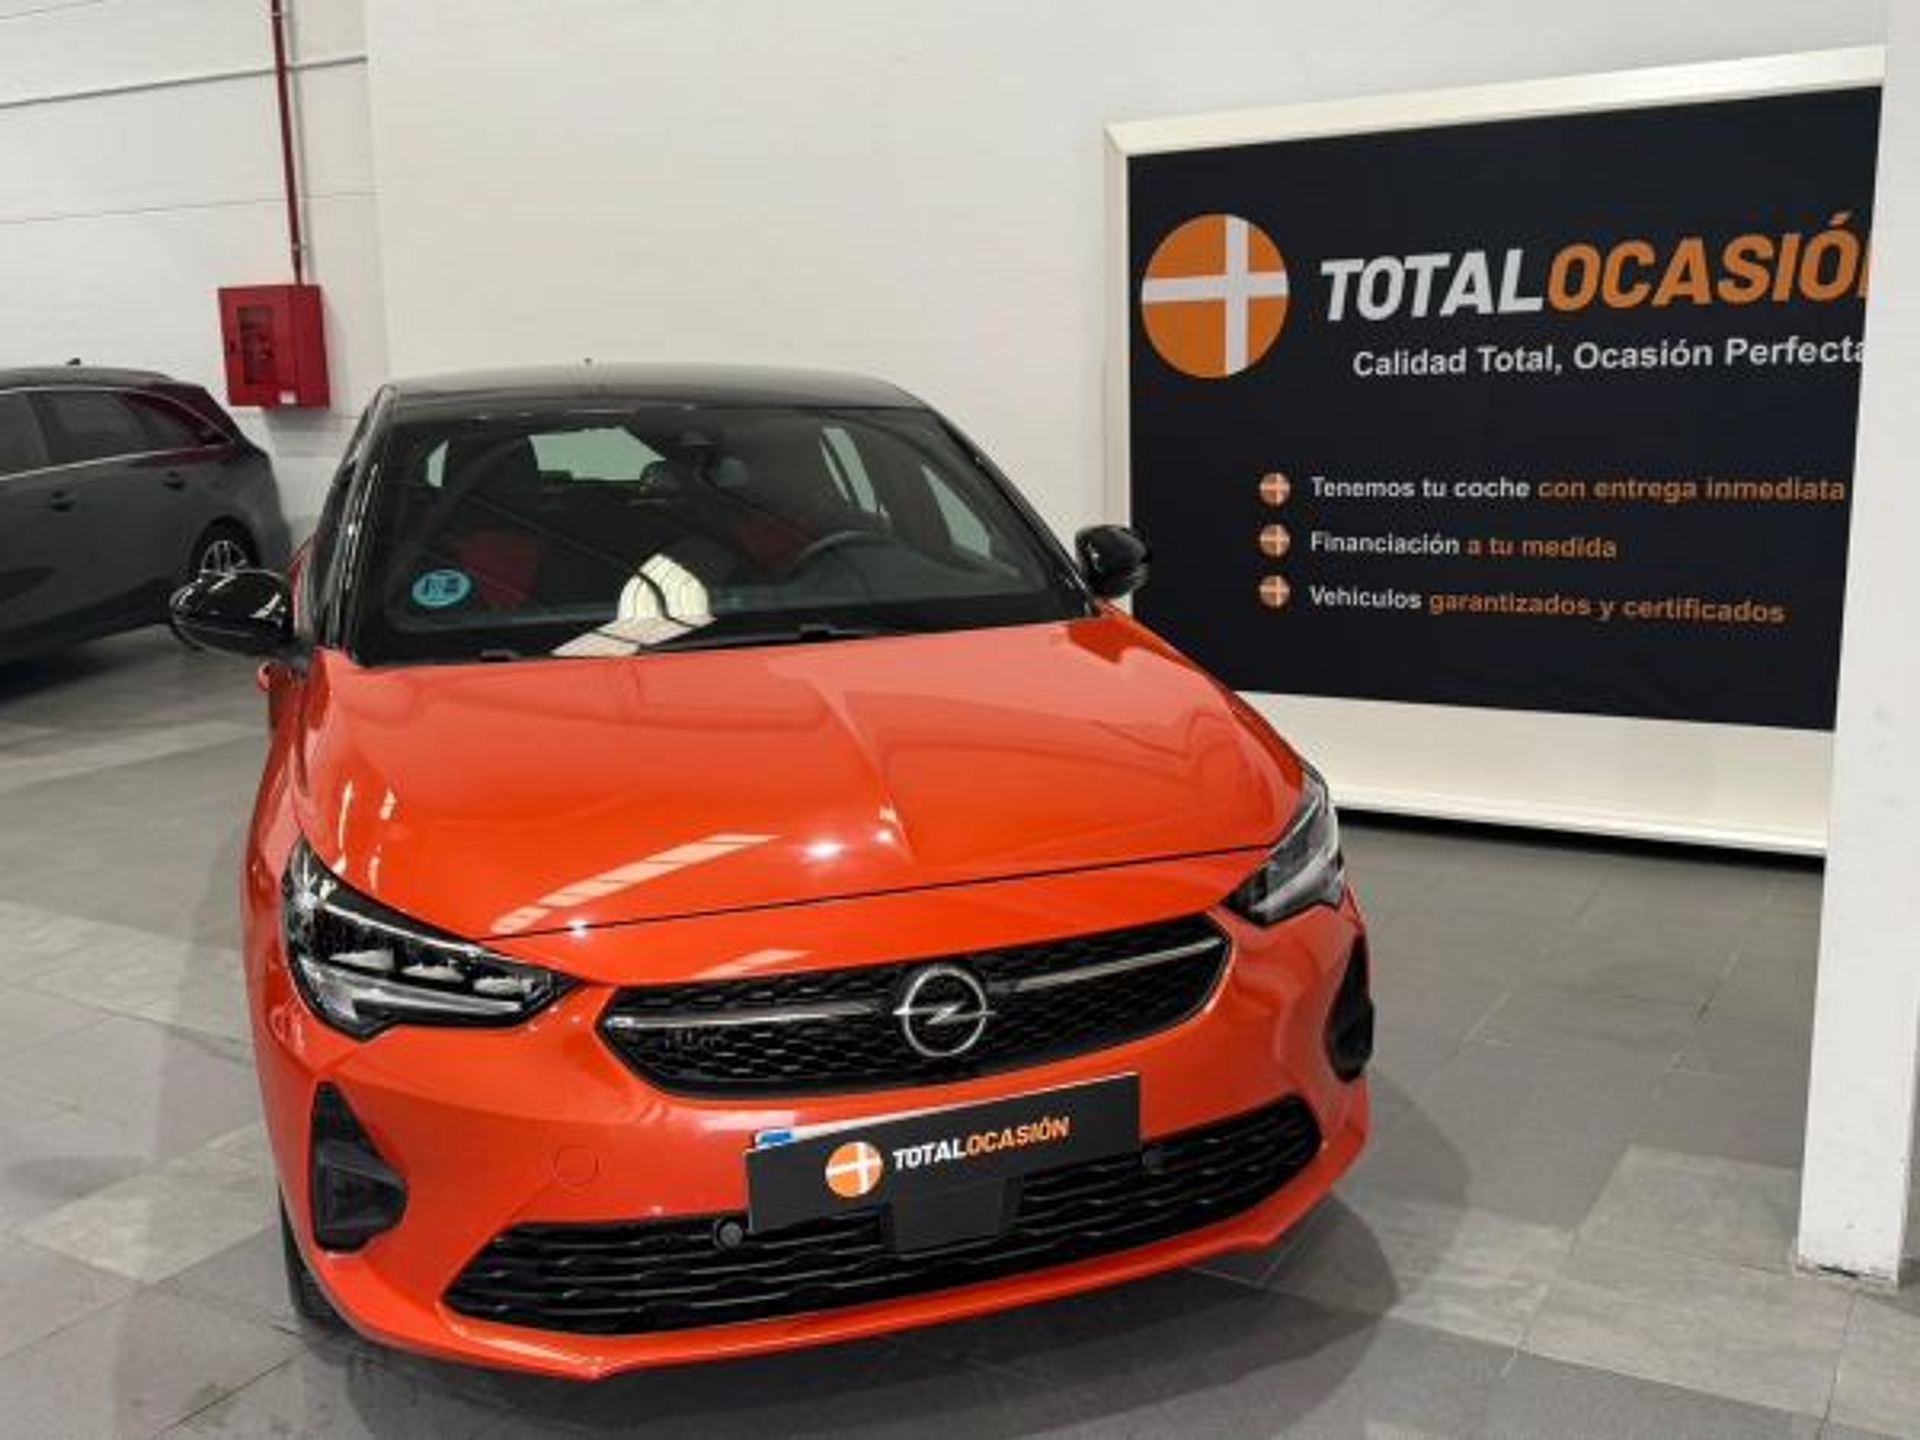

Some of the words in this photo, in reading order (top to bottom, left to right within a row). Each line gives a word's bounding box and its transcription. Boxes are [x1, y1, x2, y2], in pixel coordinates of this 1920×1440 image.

[1320, 211, 1869, 321] TOTALOCASIÓ
[1353, 348, 1467, 377] Calidad
[1477, 344, 1563, 374] Total,
[1573, 339, 1713, 369] Ocasión
[1311, 476, 1415, 498] Tenemos
[1423, 477, 1447, 497] tu
[1453, 477, 1531, 498] coche
[1538, 480, 1586, 498] con
[1593, 479, 1697, 502] entrega
[1706, 477, 1845, 500] inmediata
[1310, 531, 1460, 555] Financiación
[1467, 540, 1482, 554] a
[1489, 536, 1515, 555] tu
[1521, 537, 1617, 558] medida
[1430, 591, 1592, 615] garantizados
[1599, 600, 1614, 621] y
[1623, 596, 1786, 623] certificados
[892, 1115, 1071, 1170] TOTALOCASIÓN
